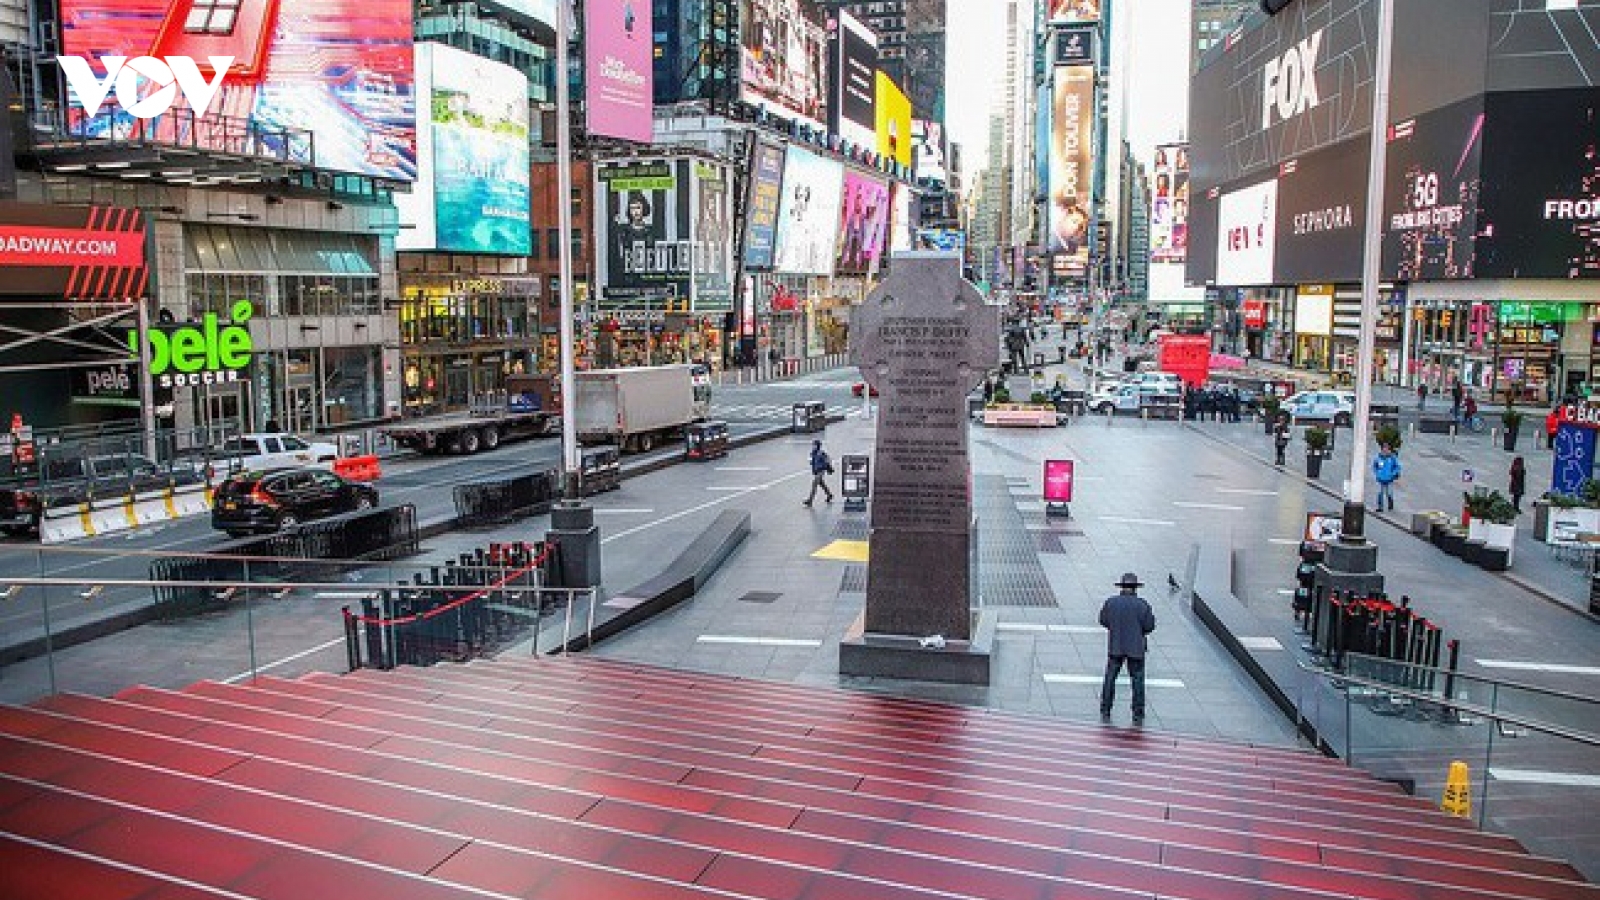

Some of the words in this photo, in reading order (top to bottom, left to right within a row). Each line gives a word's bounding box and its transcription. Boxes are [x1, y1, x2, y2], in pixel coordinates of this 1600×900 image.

[1262, 28, 1323, 129] FOX
[1414, 173, 1439, 207] 5G
[1293, 203, 1353, 235] SEPHORA
[127, 300, 253, 376] pelé
[878, 327, 921, 337] FRANCIS
[932, 327, 970, 337] DUFFY
[159, 371, 238, 388] SOCCER
